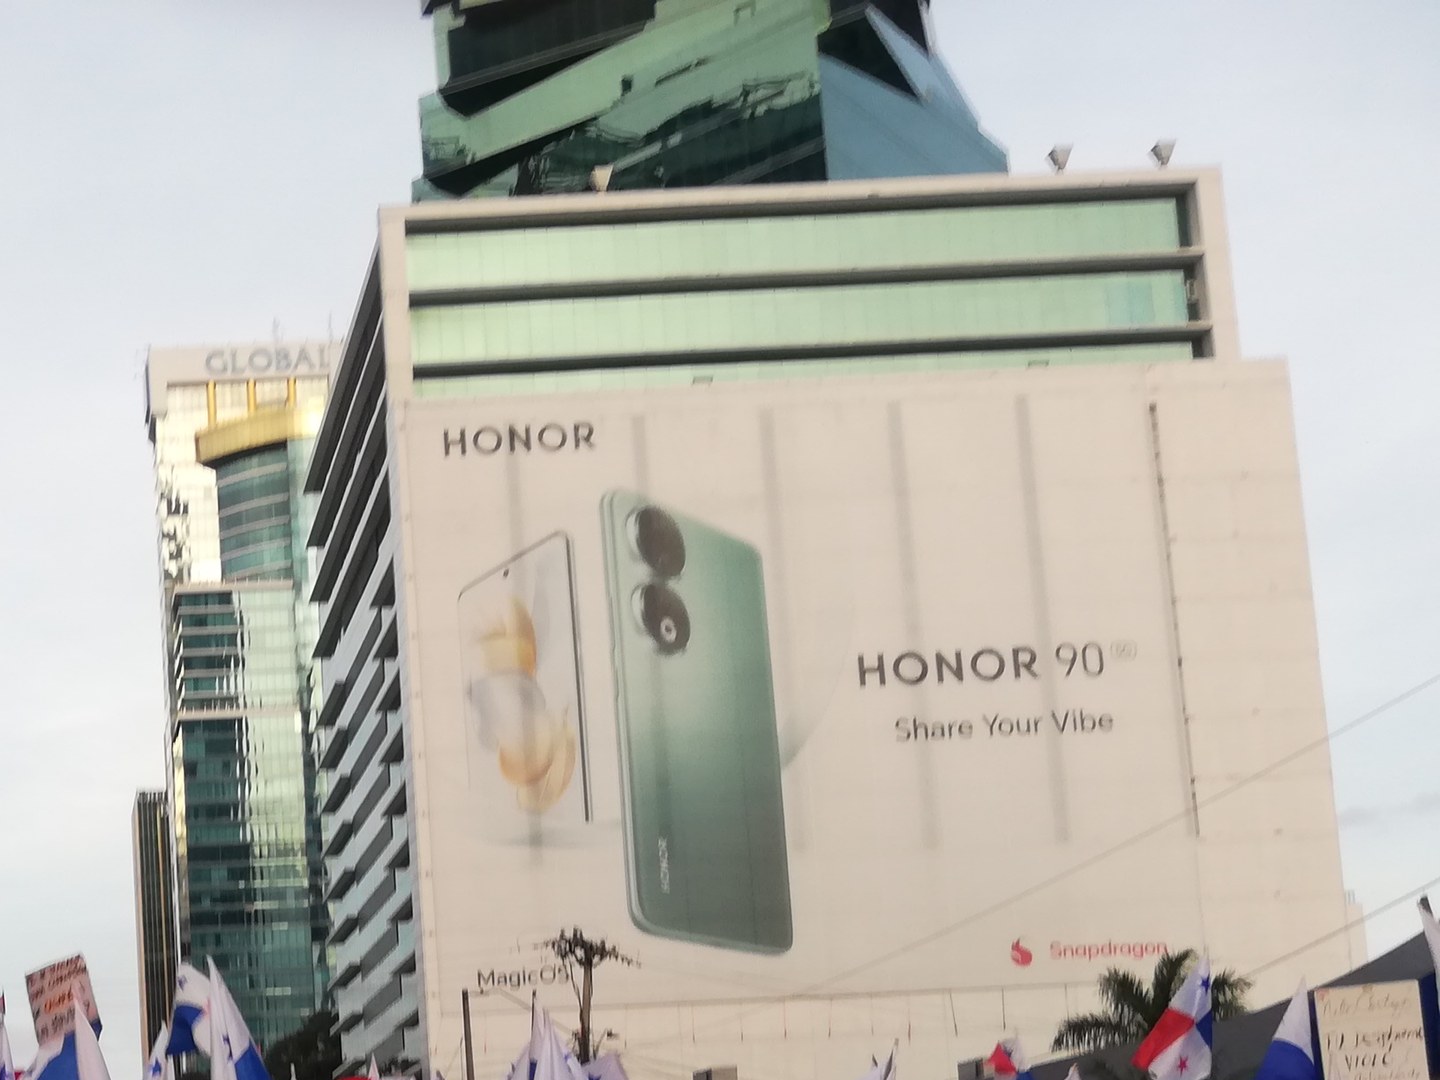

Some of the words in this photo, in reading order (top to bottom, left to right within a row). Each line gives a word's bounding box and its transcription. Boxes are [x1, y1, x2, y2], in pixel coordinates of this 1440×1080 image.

[205, 346, 330, 376] GLOBAL
[443, 422, 596, 457] HONOR
[858, 646, 1040, 686] HONOR
[1055, 641, 1105, 678] 90
[894, 716, 973, 742] Share
[982, 713, 1042, 738] Your
[1051, 707, 1114, 734] Vibe
[1050, 938, 1169, 961] Snapdragon
